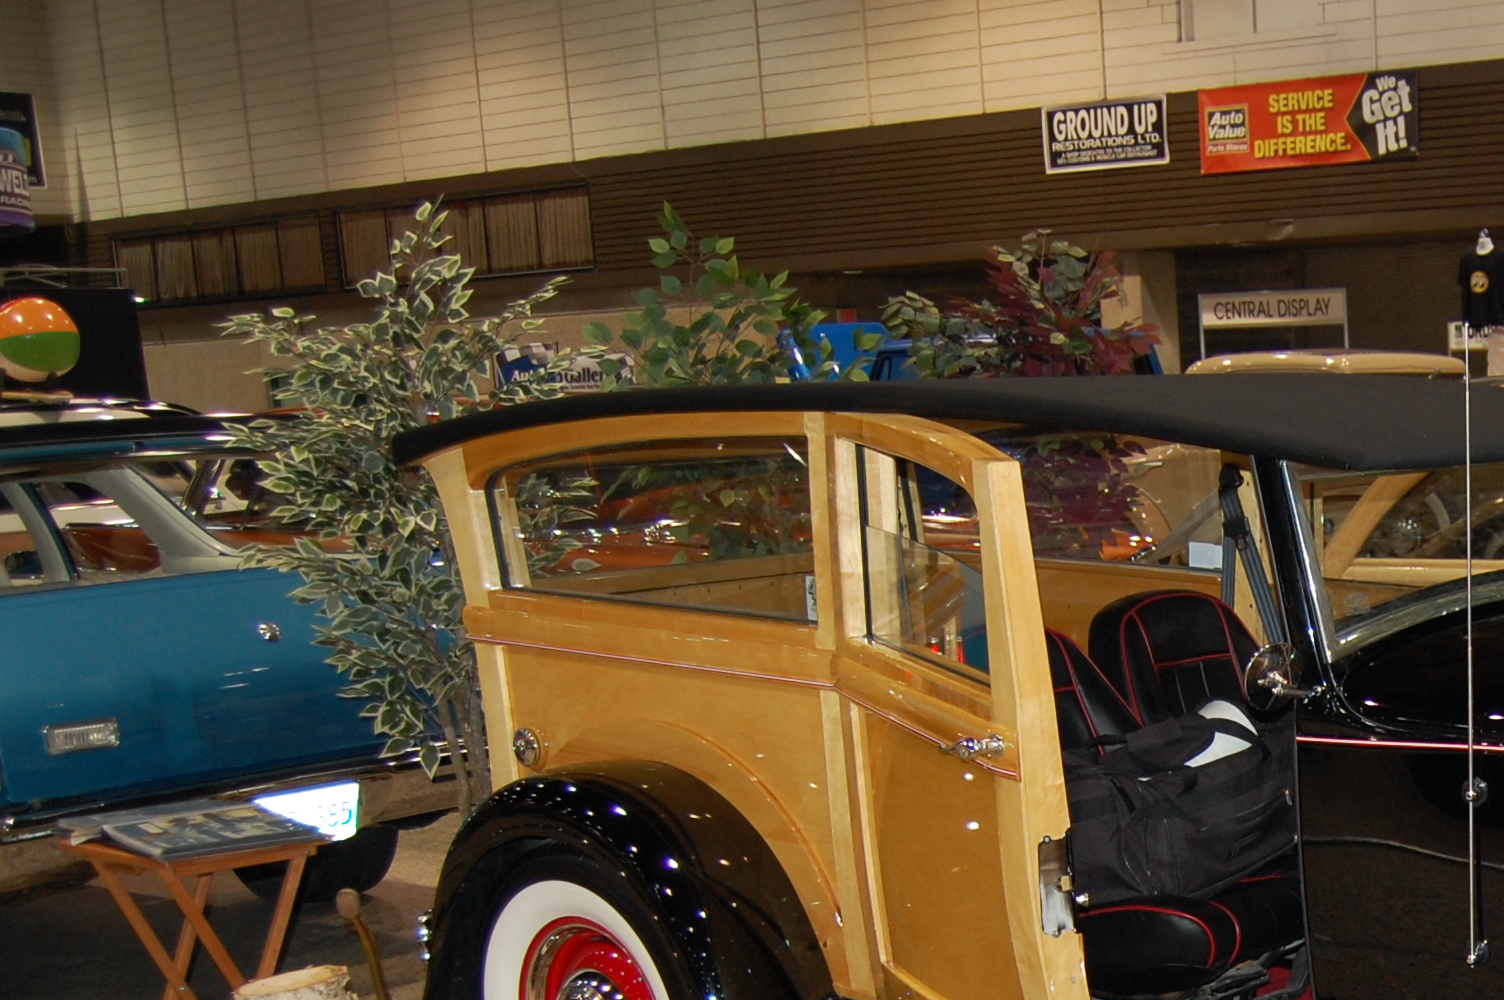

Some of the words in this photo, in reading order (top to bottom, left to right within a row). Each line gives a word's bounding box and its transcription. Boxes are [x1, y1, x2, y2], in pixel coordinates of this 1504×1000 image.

[1375, 74, 1396, 92] We
[1268, 88, 1334, 113] SERVICE
[1361, 79, 1412, 124] Get
[1052, 106, 1129, 142] GROUND
[1133, 102, 1158, 134] UP
[1210, 110, 1244, 126] Auto
[1277, 116, 1293, 134] IS
[1296, 112, 1326, 132] THE
[1052, 134, 1135, 152] RESTORATIONS
[1137, 132, 1162, 144] LTD.
[1208, 124, 1246, 140] Value
[1375, 115, 1408, 156] It!
[1253, 132, 1352, 158] DIFFERENCE.
[1213, 300, 1274, 320] CENTRAL
[1277, 297, 1331, 318] DISPLAY
